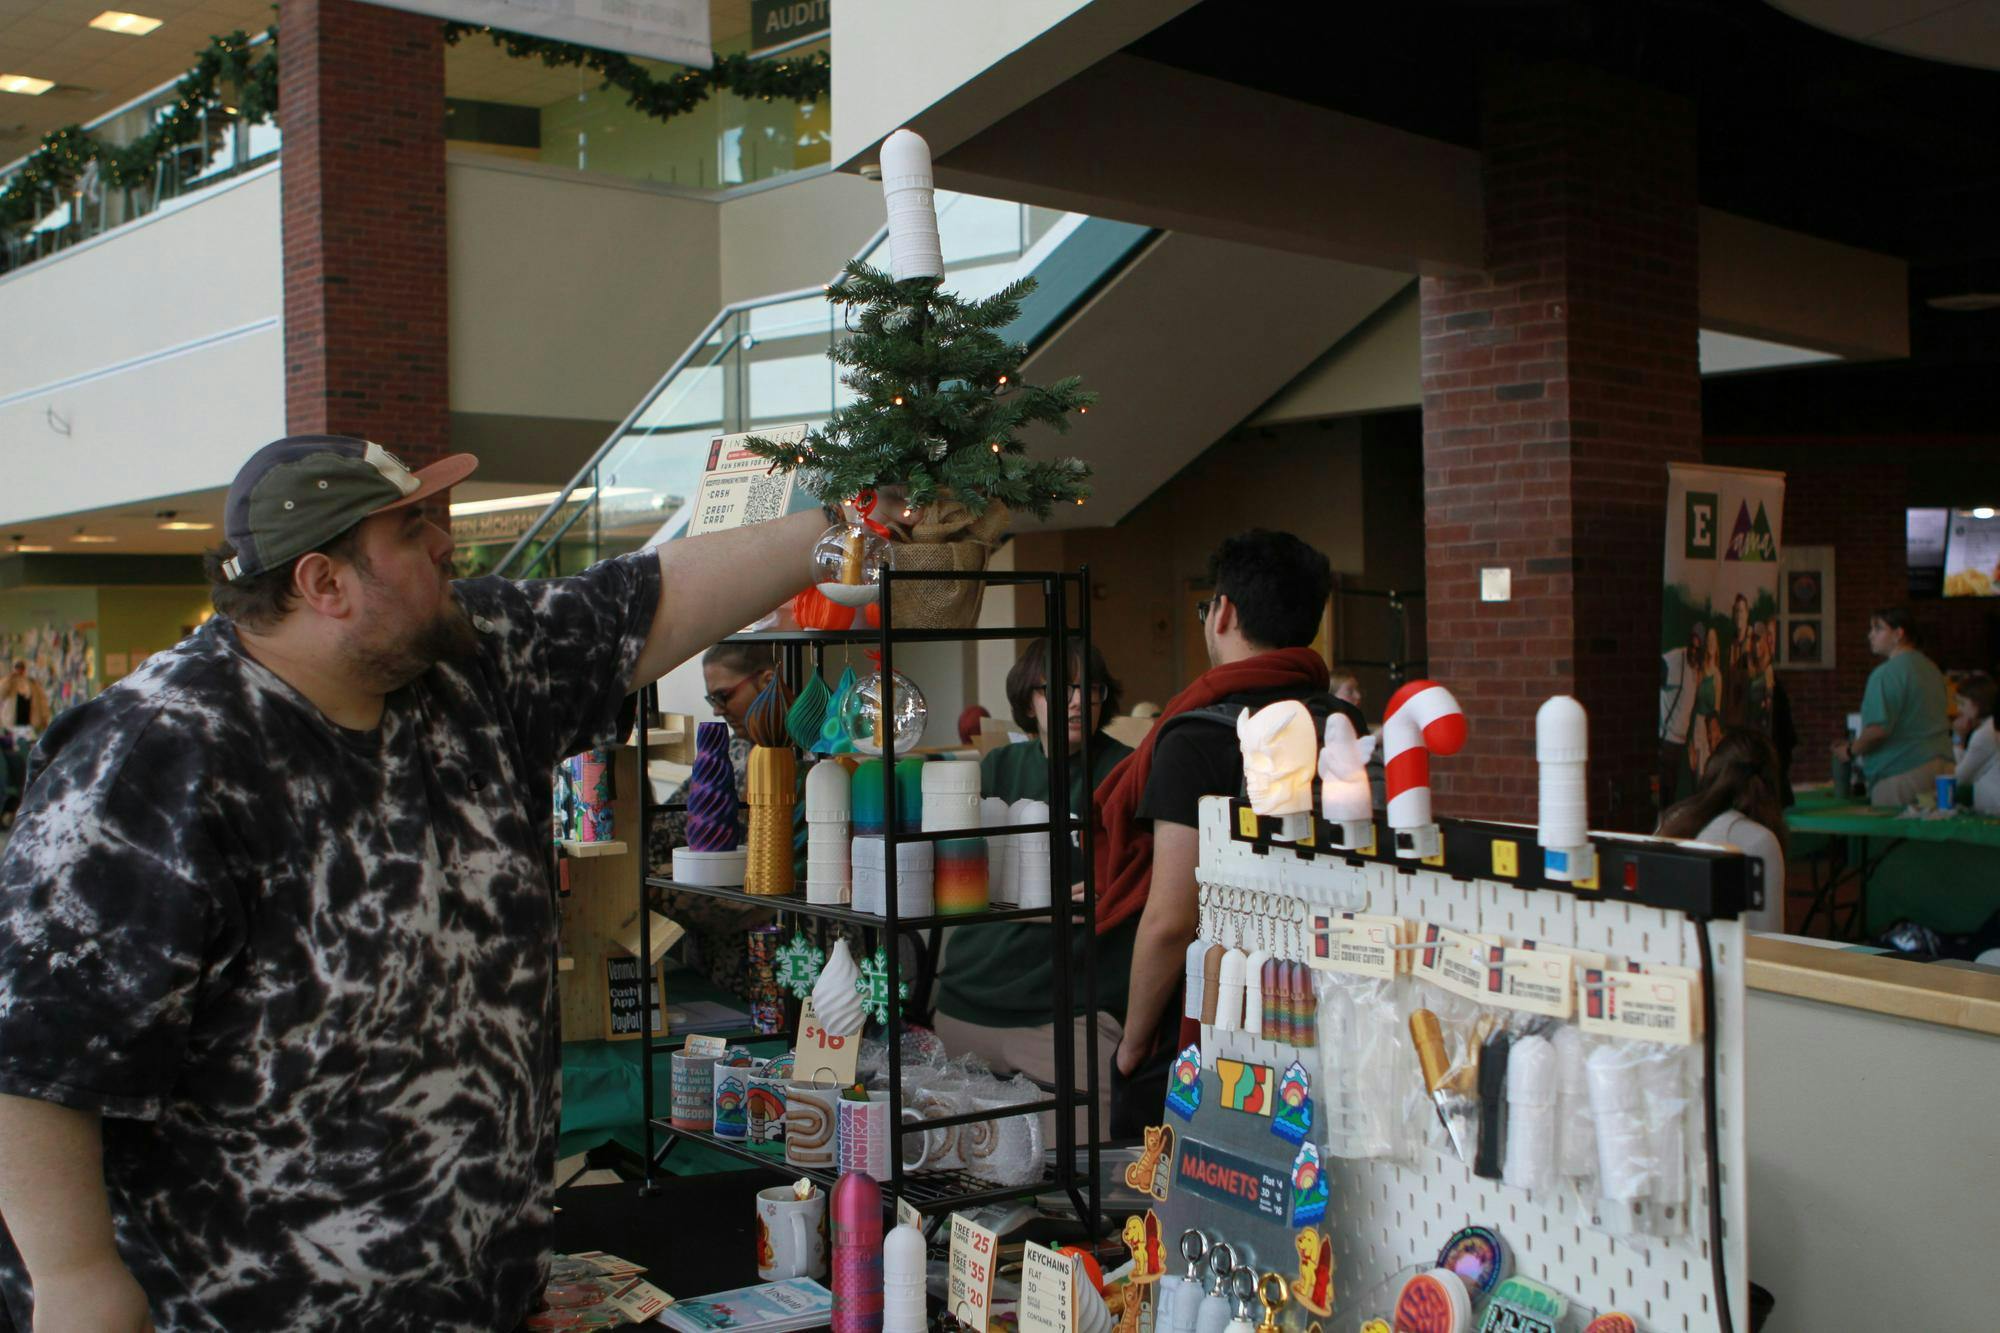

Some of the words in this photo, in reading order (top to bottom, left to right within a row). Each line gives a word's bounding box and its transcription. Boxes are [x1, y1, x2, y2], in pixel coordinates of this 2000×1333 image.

[766, 0, 831, 33] AUDIT
[709, 489, 731, 499] CASH
[703, 514, 725, 525] CARD
[705, 504, 735, 515] CREDIT
[1692, 505, 1712, 547] E
[608, 960, 635, 981] Venmo
[788, 955, 809, 981] E
[610, 986, 637, 998] Cash
[613, 998, 636, 1008] App
[612, 1011, 640, 1034] PayPal
[676, 1095, 701, 1106] CRAB
[1181, 1153, 1259, 1201] MAGNETS
[954, 1222, 970, 1237] TREE
[971, 1230, 990, 1254] $25
[953, 1253, 967, 1268] TREE
[968, 1260, 985, 1283] $35
[1027, 1248, 1070, 1275] KEYCHAINS
[1028, 1268, 1042, 1280] FLAT
[967, 1286, 983, 1309] $20
